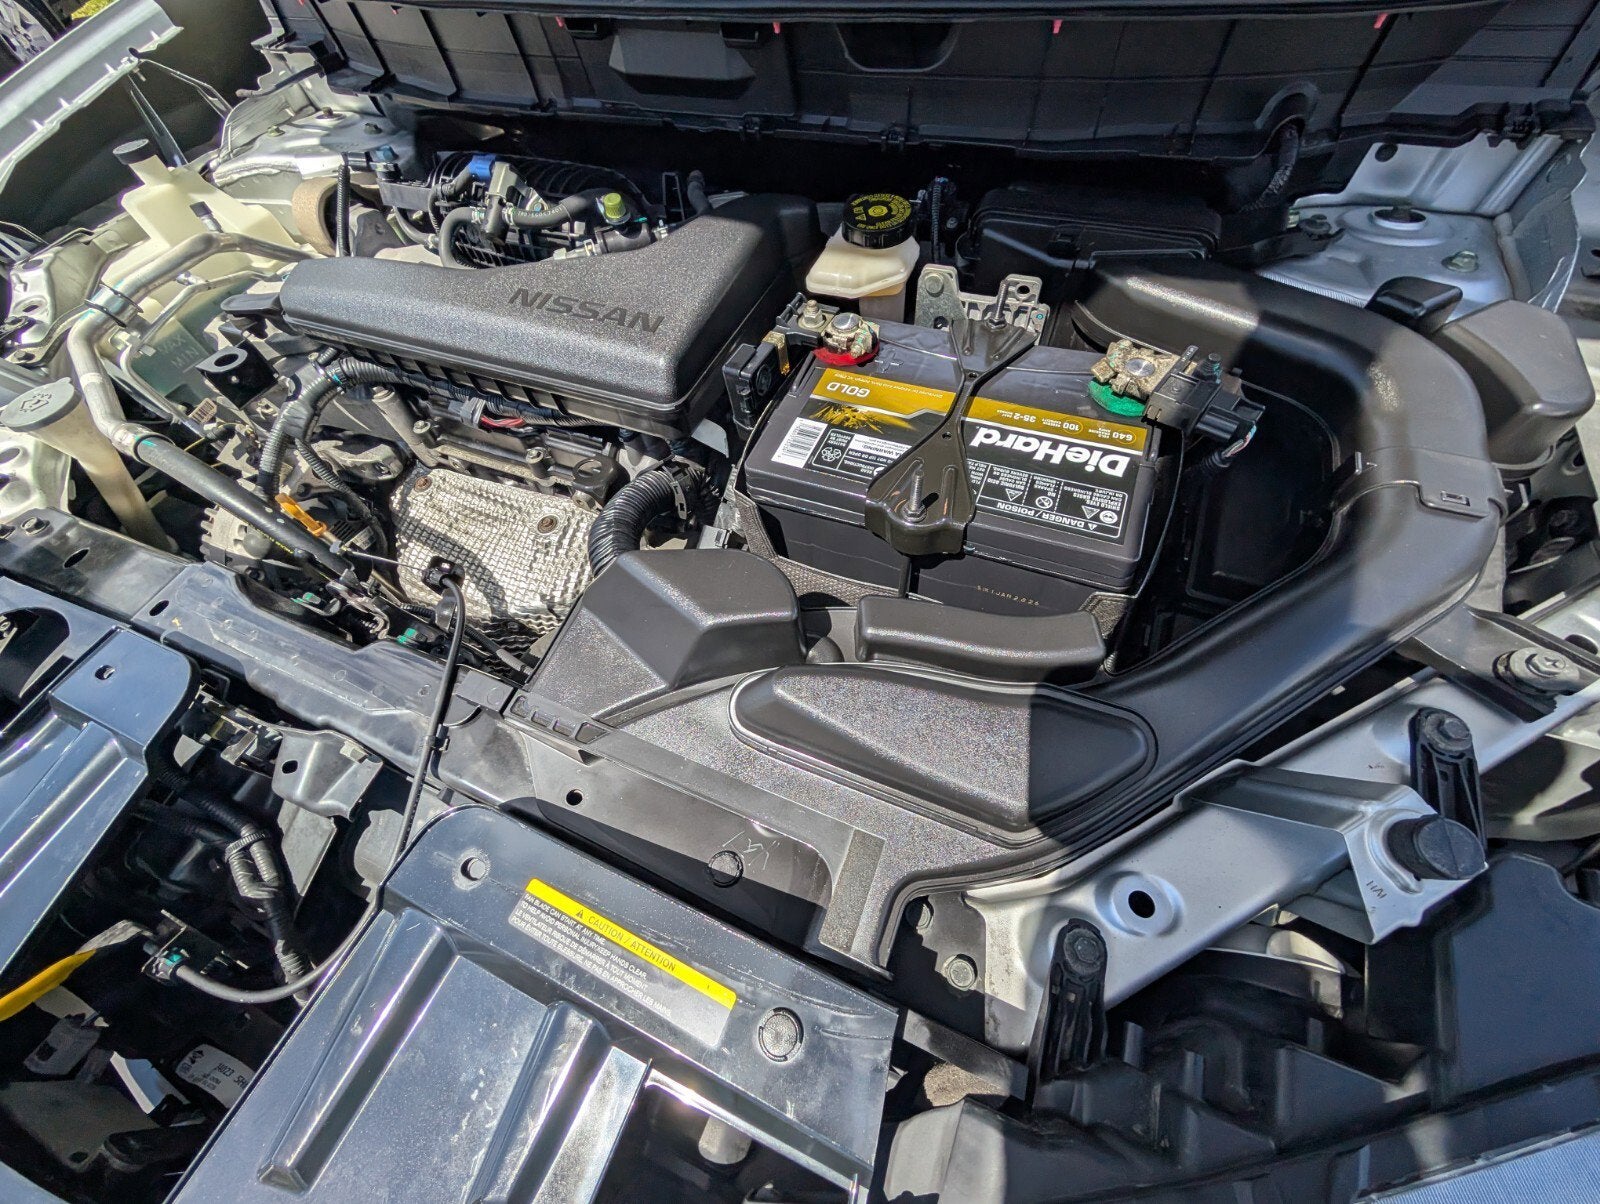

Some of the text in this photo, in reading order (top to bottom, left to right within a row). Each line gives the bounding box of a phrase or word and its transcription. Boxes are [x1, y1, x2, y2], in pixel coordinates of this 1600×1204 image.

[509, 287, 664, 333] NISSAN
[827, 382, 870, 398] GOLD
[1062, 422, 1080, 431] 100
[1112, 431, 1133, 441] 640
[970, 427, 1130, 477] DieHard
[997, 502, 1035, 516] POISON
[1041, 512, 1085, 527] DANGER
[519, 900, 528, 909] TO
[527, 904, 540, 916] HELP
[539, 911, 555, 924] AVOID
[553, 920, 581, 940] PERSONAL
[595, 945, 611, 958] KEEP
[609, 953, 630, 969] HANDS
[533, 898, 550, 912] BLADE
[549, 908, 561, 918] CAN
[560, 914, 576, 927] START
[574, 923, 583, 931] AT
[581, 927, 593, 937] ANY
[510, 915, 526, 928] POUR
[540, 933, 558, 947] TOUTE
[583, 959, 594, 969] NE
[592, 964, 603, 974] PAS
[601, 969, 611, 979] EN
[609, 975, 644, 999] APPROCHER
[641, 994, 654, 1005] LES
[515, 908, 523, 917] LE
[550, 929, 571, 945] RISQUE
[569, 941, 578, 949] DE
[609, 964, 625, 977] TOUT
[588, 916, 623, 940] CAUTION
[630, 941, 676, 971] ATTENTION
